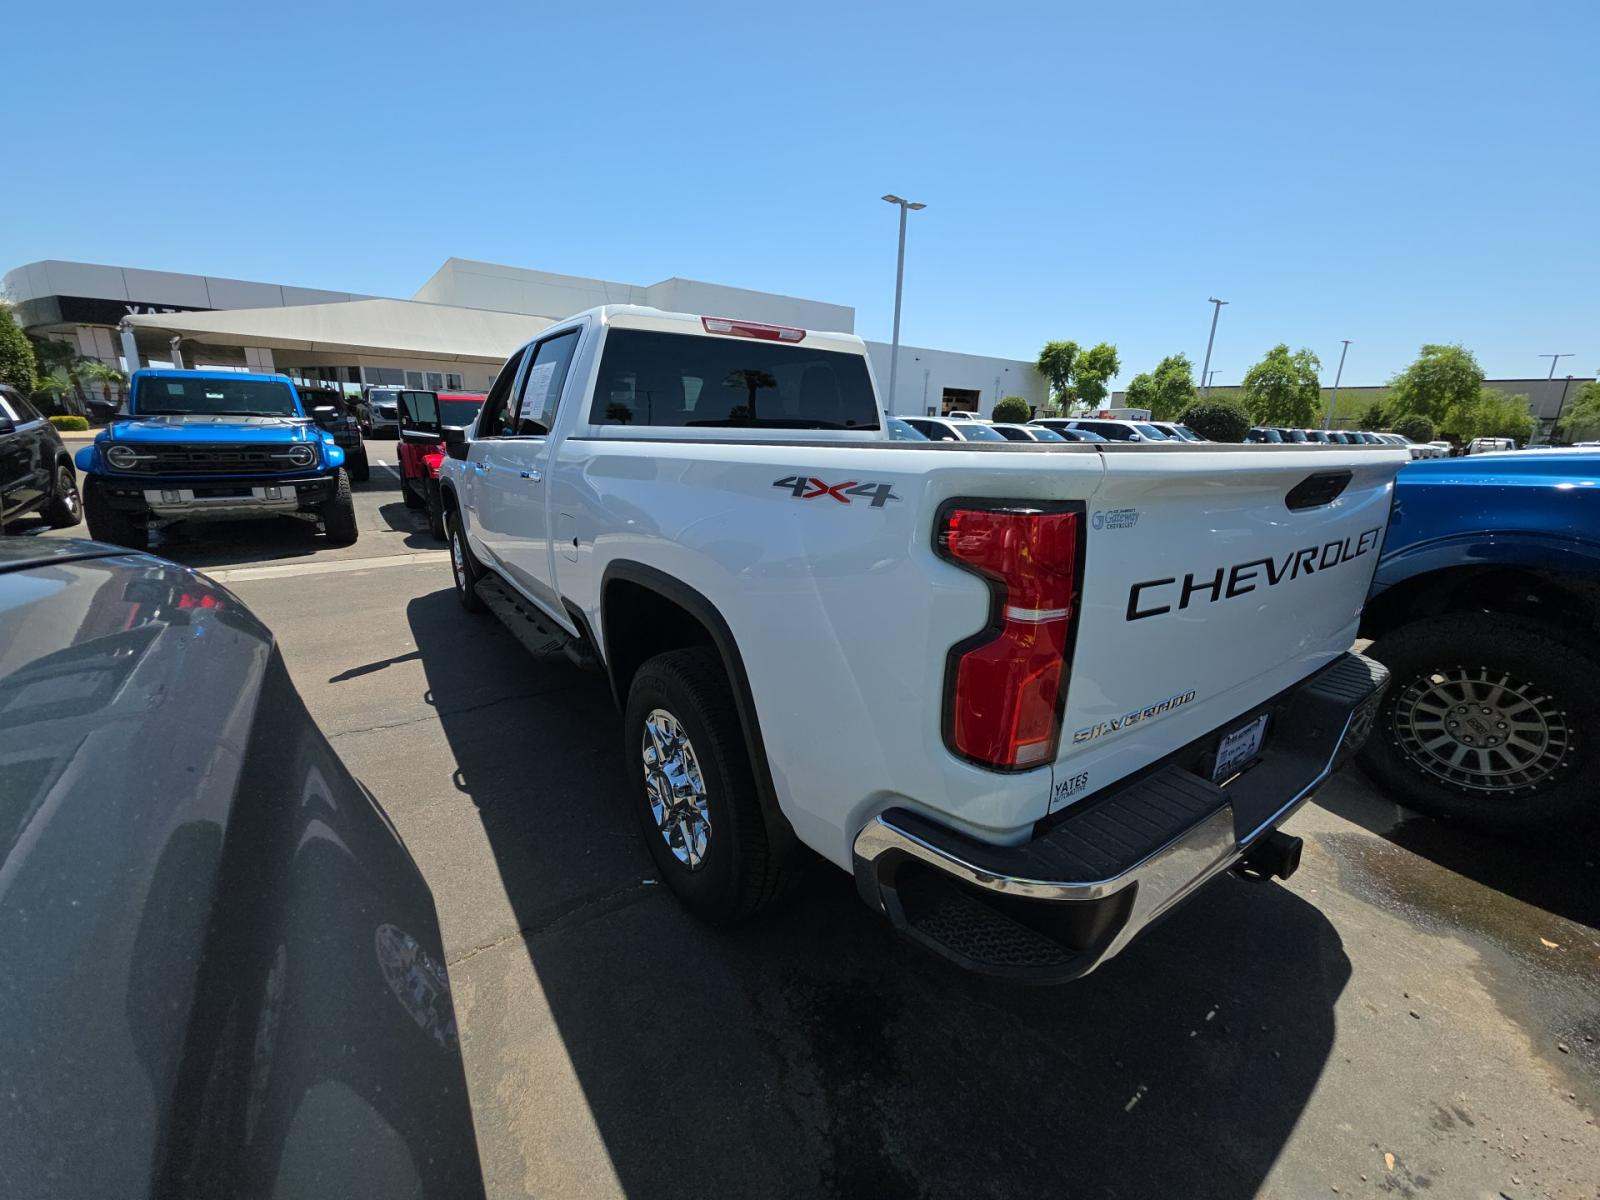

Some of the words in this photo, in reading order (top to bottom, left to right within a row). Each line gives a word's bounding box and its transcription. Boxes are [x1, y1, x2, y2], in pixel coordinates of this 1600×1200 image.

[1126, 526, 1383, 622] CHEVROLET
[1072, 691, 1196, 744] SILVERADO
[1055, 771, 1089, 796] YATES
